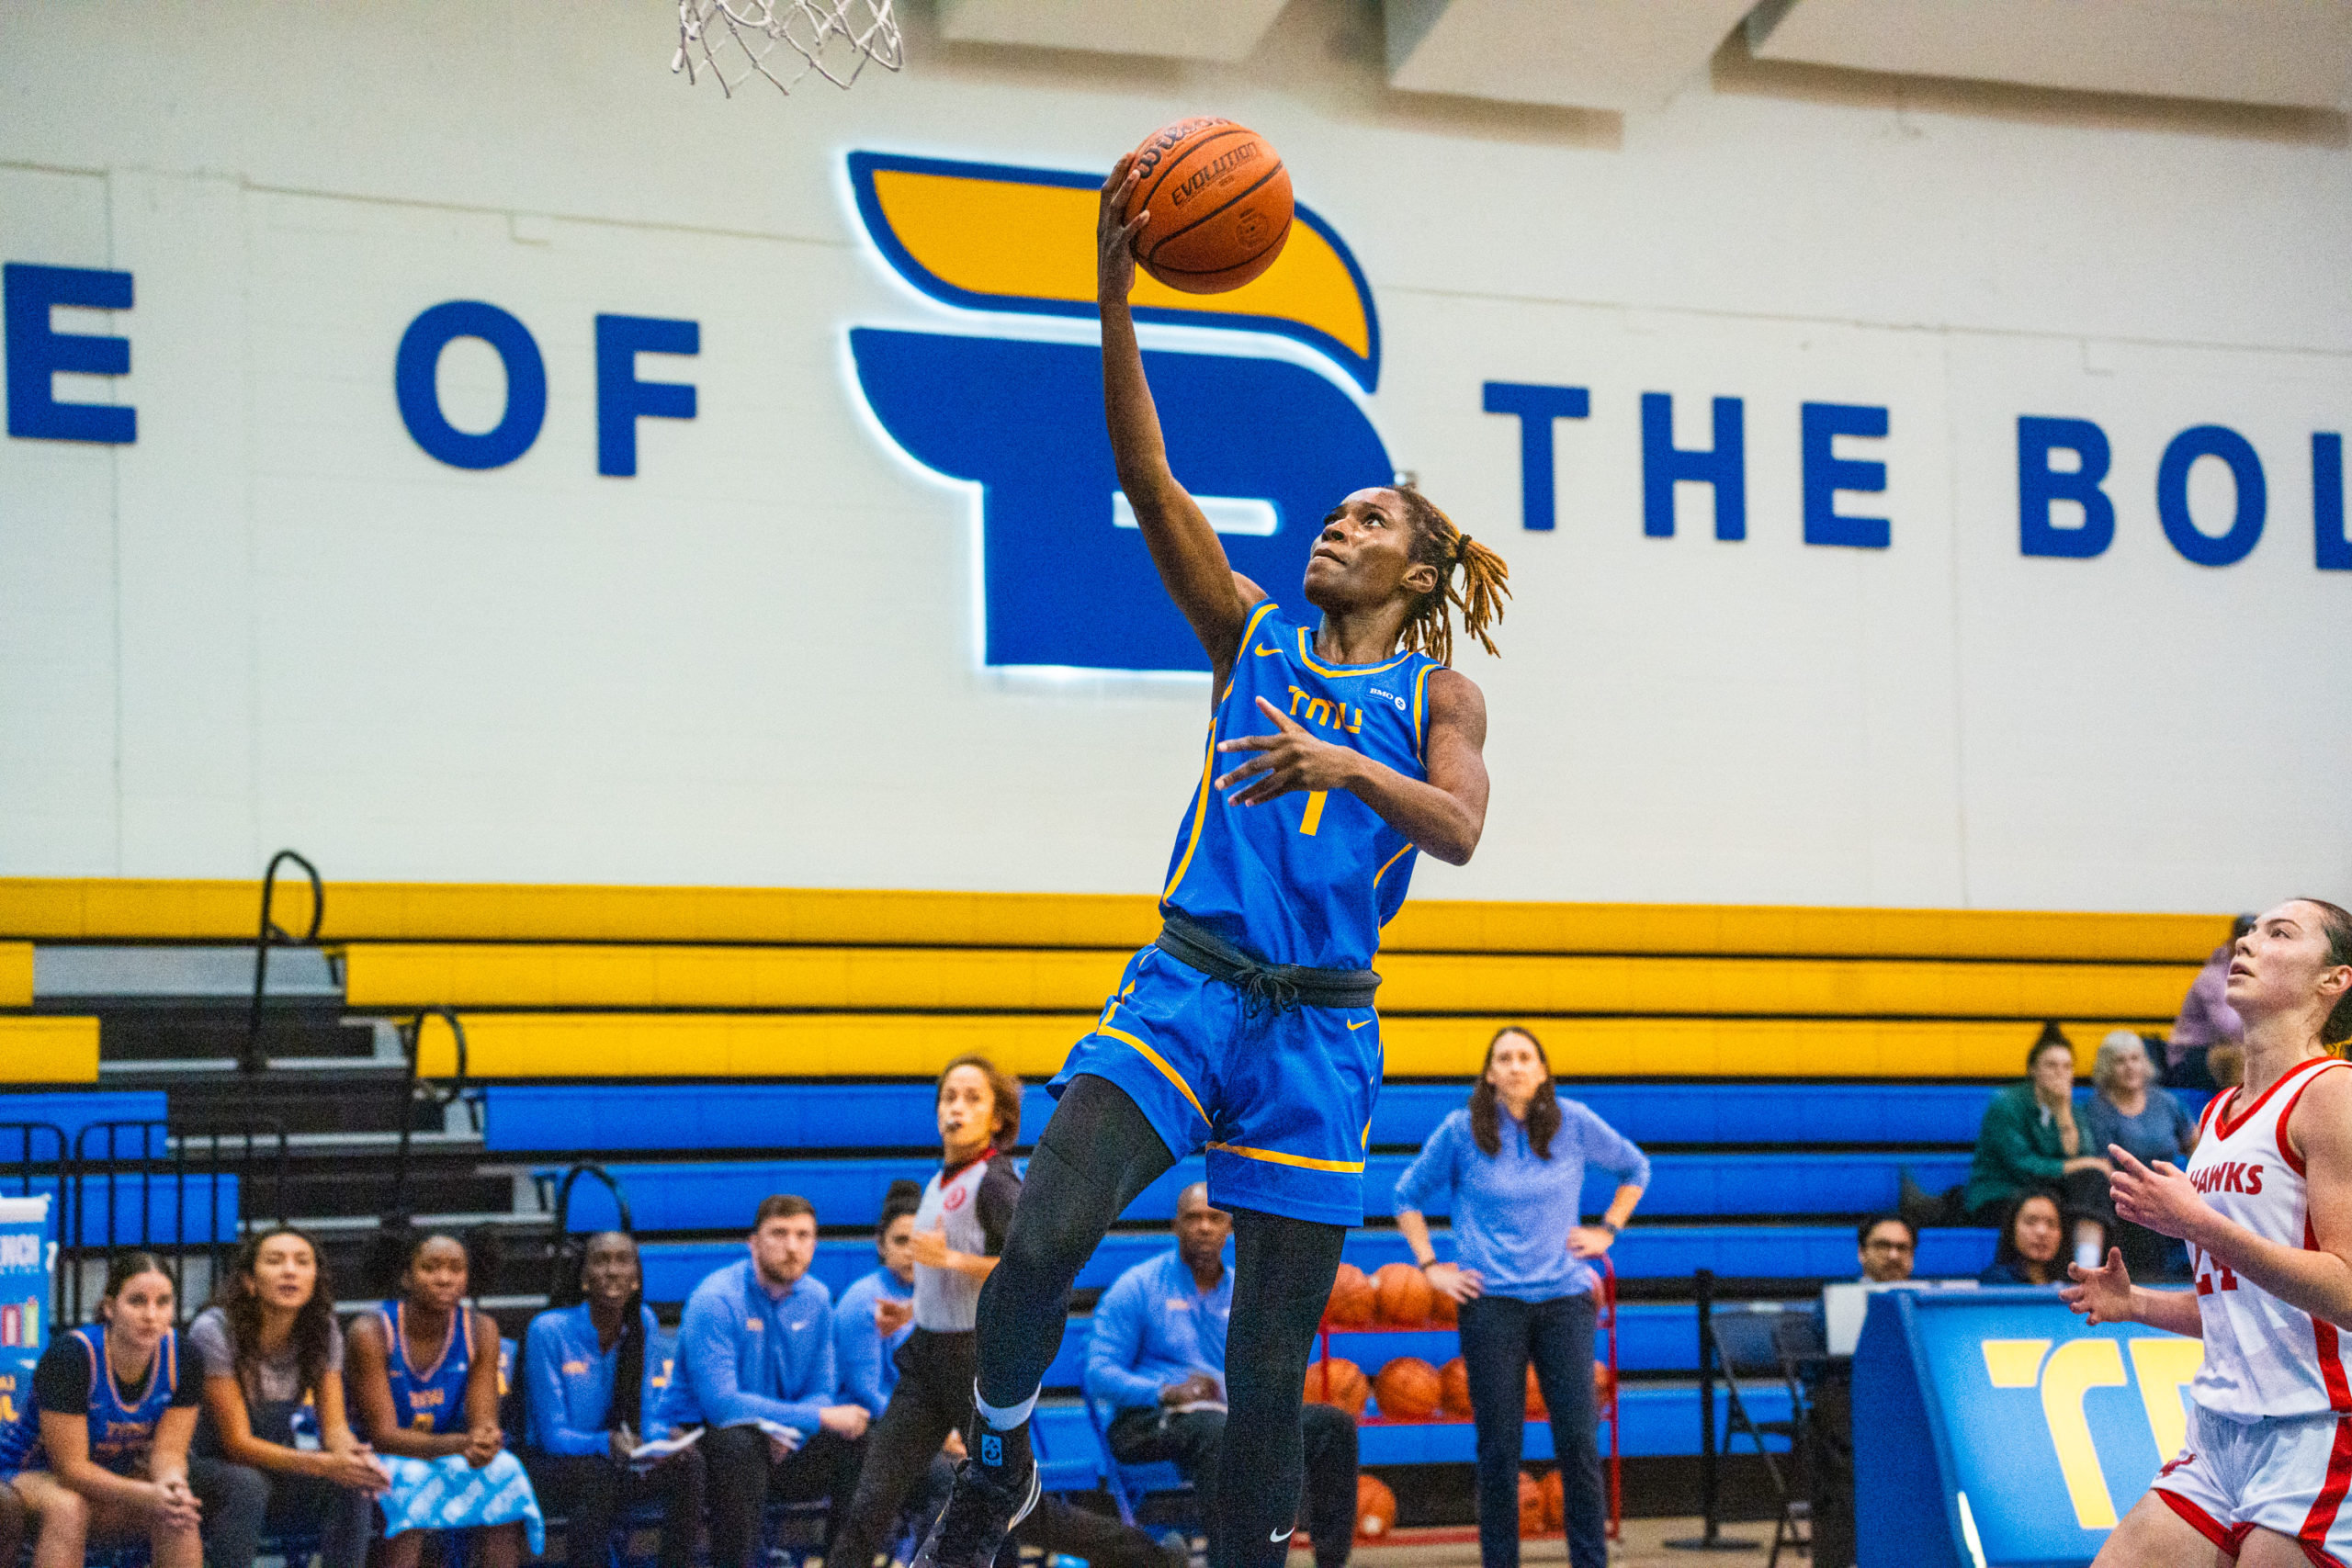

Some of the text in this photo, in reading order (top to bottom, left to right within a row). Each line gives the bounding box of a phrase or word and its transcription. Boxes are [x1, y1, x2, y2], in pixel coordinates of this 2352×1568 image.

[1171, 141, 1258, 207] EVOLUTION
[394, 299, 700, 478] OF
[1482, 381, 1891, 549] THE
[1288, 685, 1363, 734] TMU
[1370, 688, 1394, 700] BMO
[2189, 1161, 2265, 1196] HAWKS
